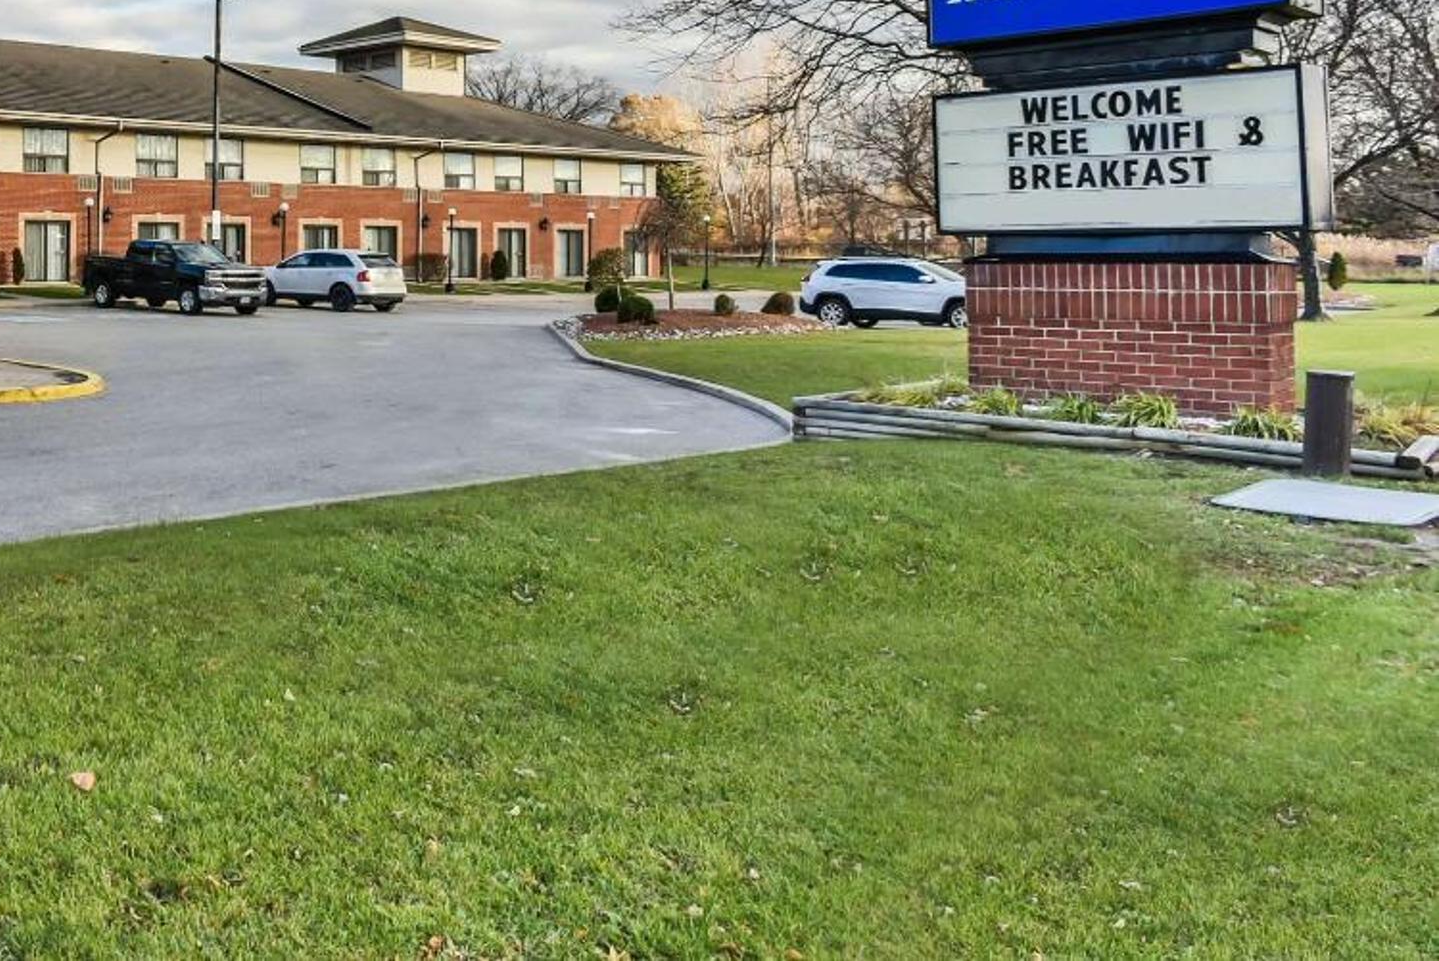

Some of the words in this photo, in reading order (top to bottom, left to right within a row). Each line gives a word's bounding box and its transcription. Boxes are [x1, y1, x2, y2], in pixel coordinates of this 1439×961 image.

[1021, 85, 1183, 125] WELCOME
[1007, 128, 1089, 157] FREE
[1127, 120, 1206, 152] WIFI
[1239, 115, 1264, 147] &
[1008, 156, 1212, 191] BREAKFAST
